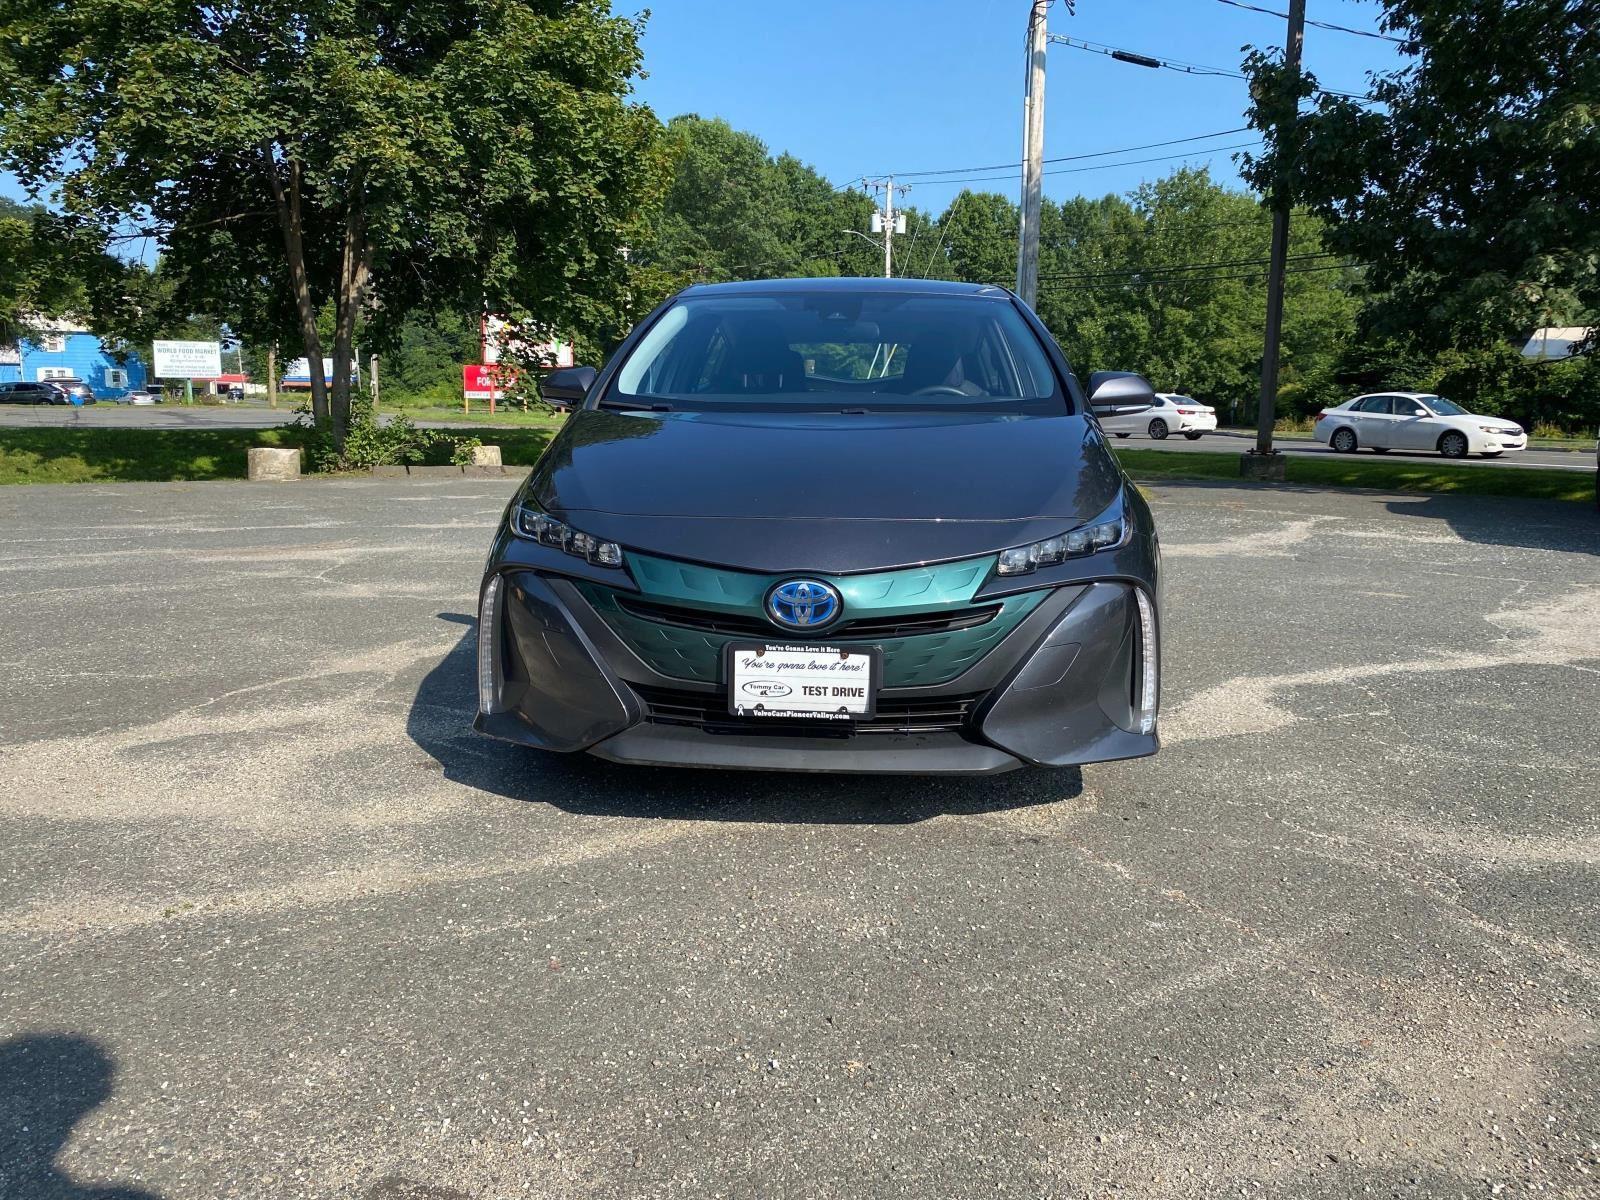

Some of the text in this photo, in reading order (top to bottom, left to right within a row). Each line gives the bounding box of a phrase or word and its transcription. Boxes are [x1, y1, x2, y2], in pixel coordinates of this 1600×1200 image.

[742, 658, 866, 672] You're gonna love it here!
[802, 686, 864, 698] TEST DRIVE
[753, 710, 850, 720] VolvoCarsPioneerValley.com
